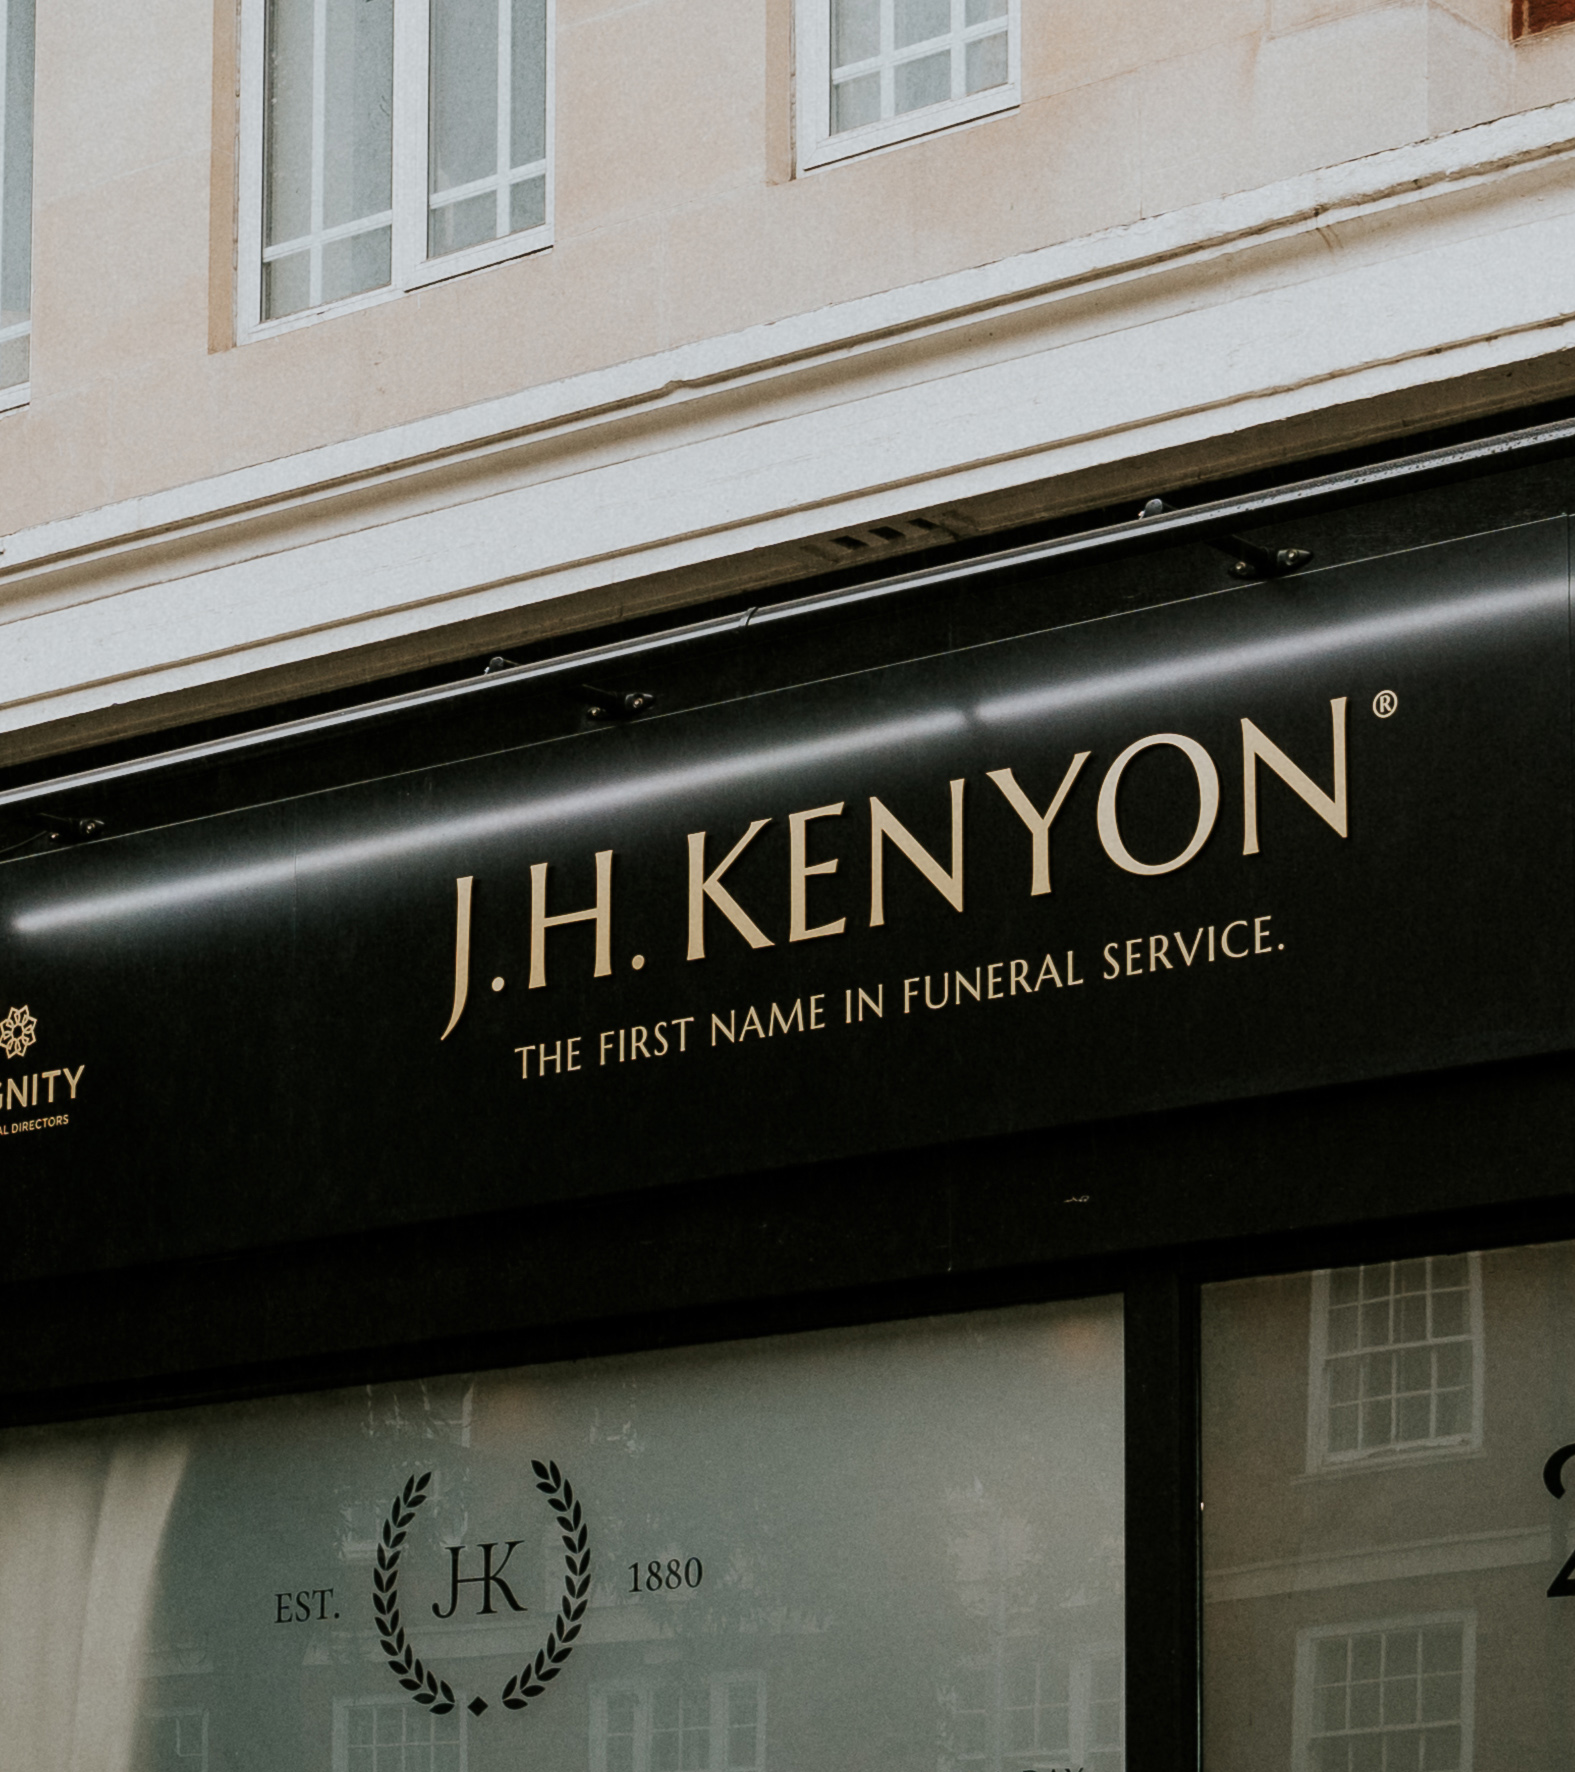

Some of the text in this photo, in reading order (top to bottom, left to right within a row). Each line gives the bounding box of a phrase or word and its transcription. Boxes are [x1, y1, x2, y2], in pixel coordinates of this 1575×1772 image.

[440, 848, 646, 1041] J.H.
[514, 914, 1286, 1081] THE FIRST NAME IN FUNERAL SERVICE.
[11, 1113, 70, 1136] DIRECTORS
[274, 1556, 705, 1625] EST. 1880
